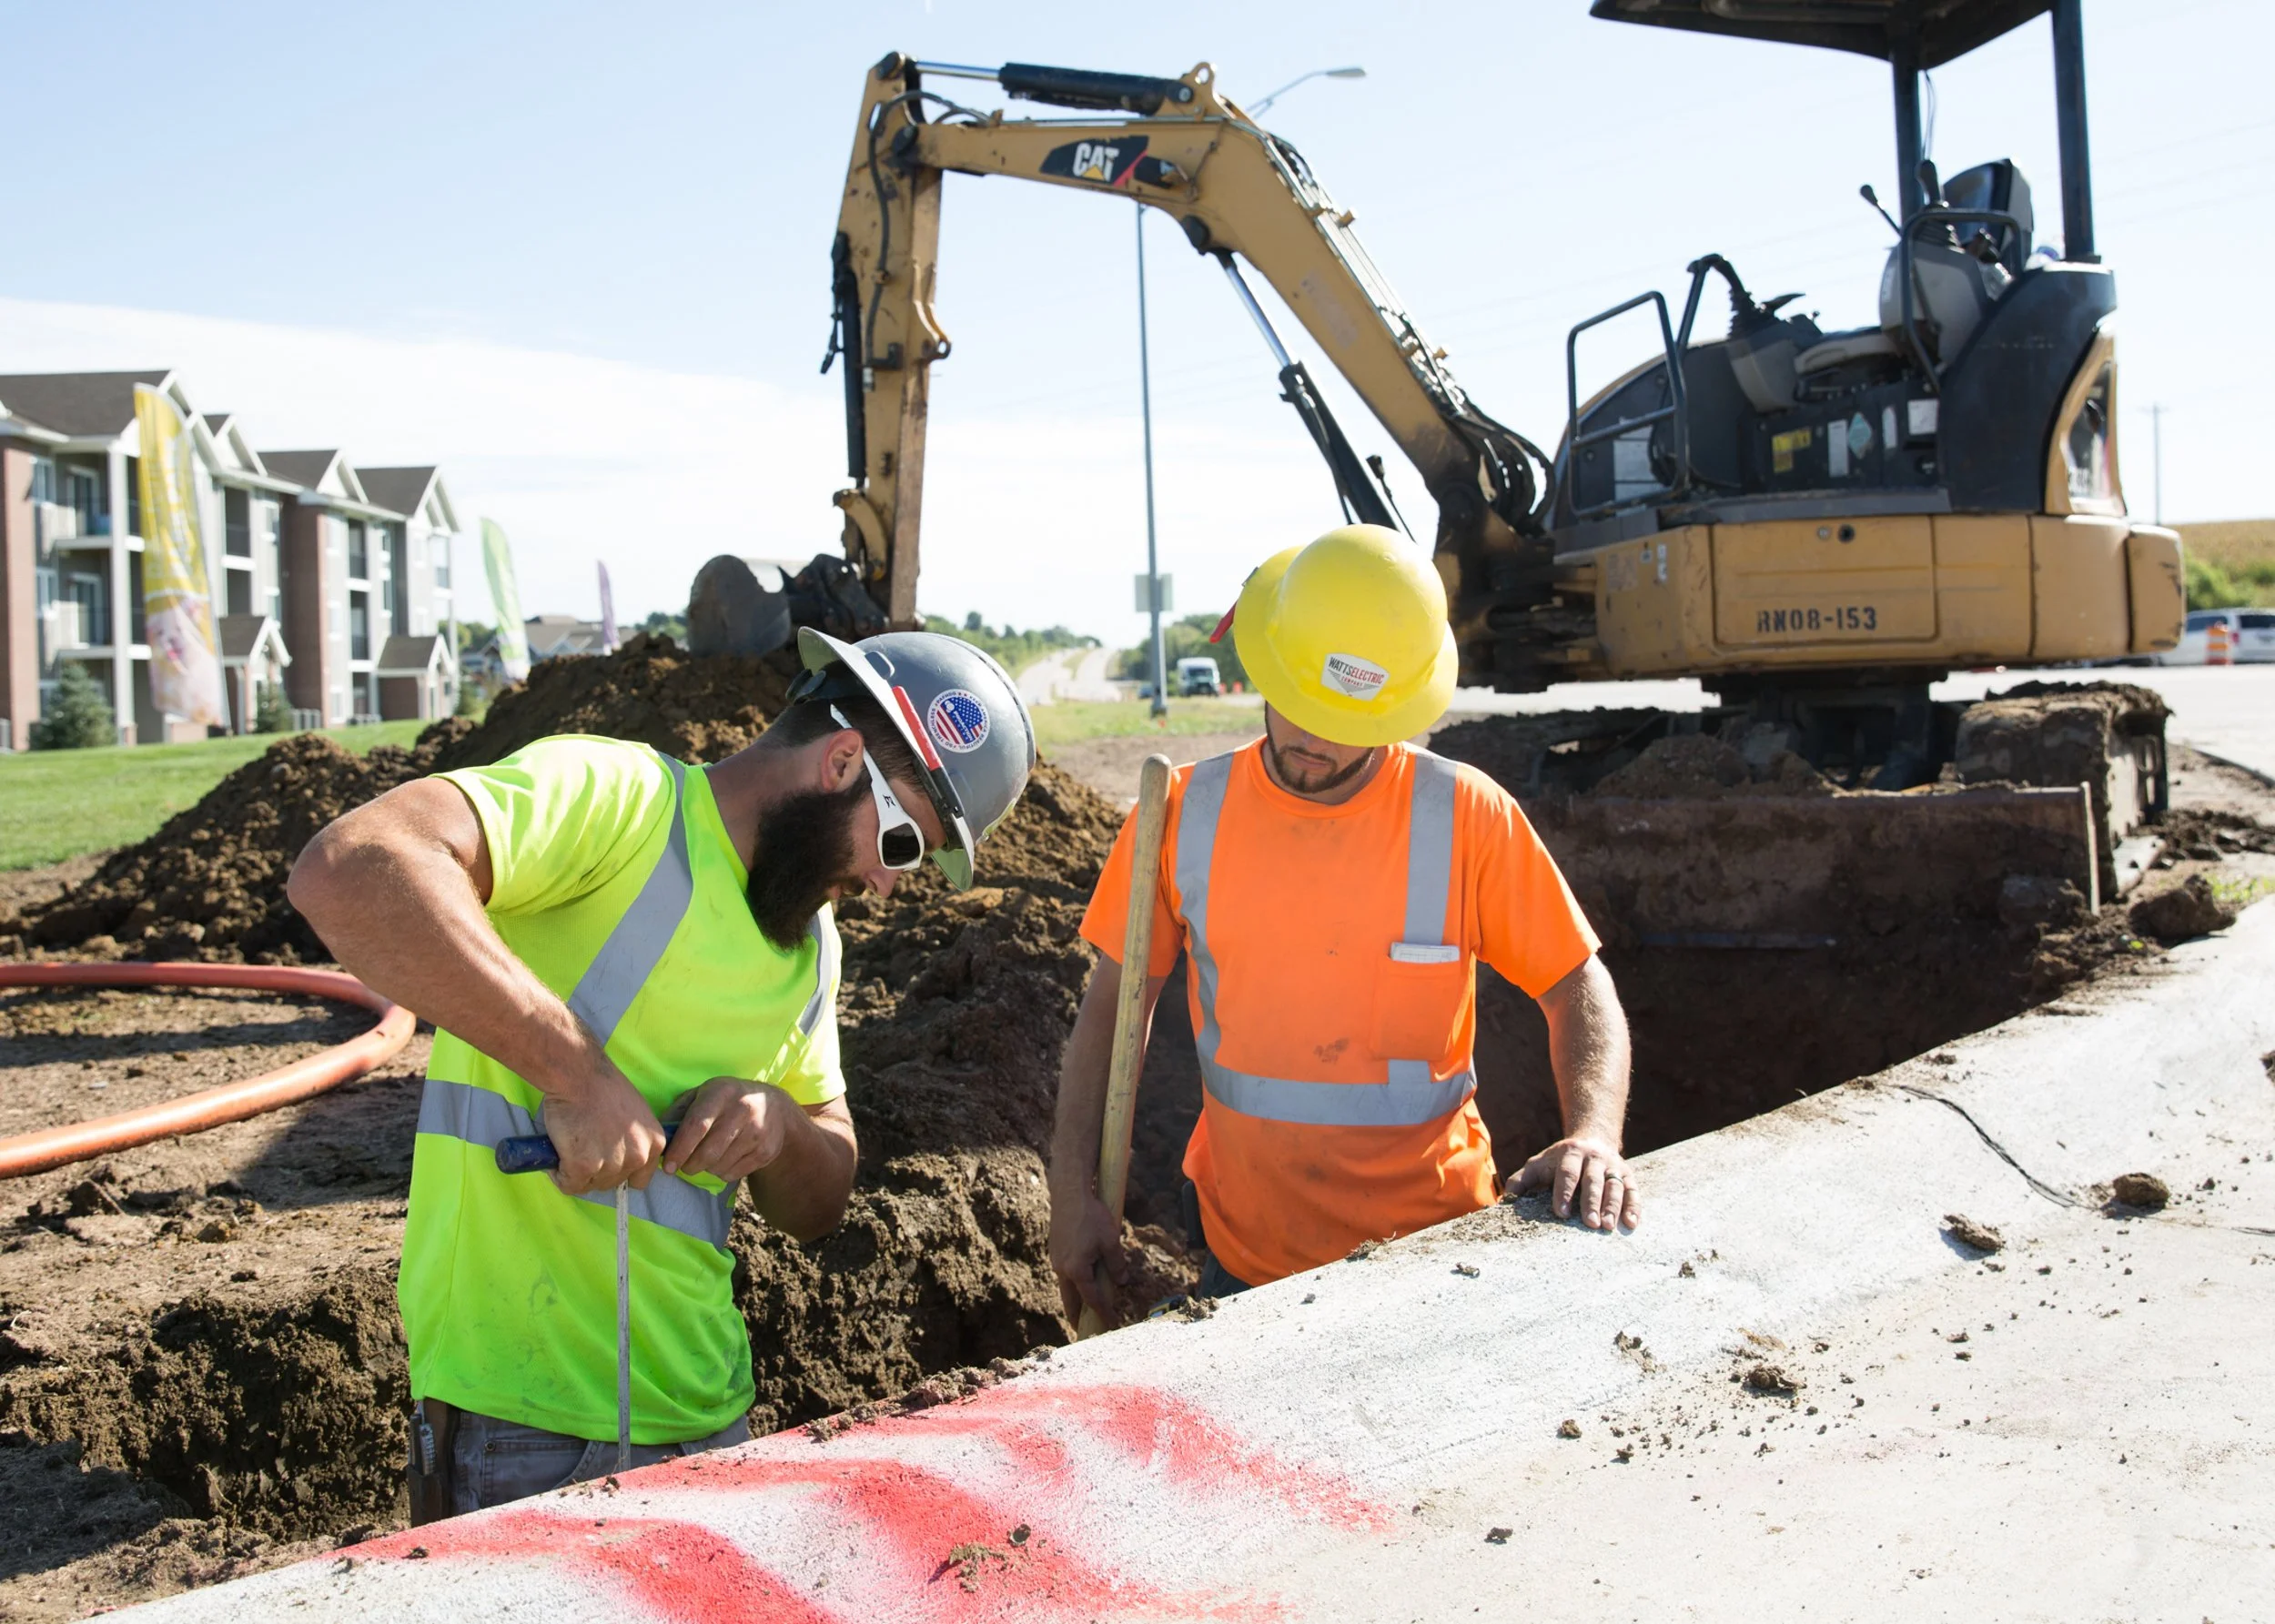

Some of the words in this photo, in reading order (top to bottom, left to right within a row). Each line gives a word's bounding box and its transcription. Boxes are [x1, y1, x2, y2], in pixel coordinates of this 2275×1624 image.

[1072, 142, 1120, 182] CAT
[1756, 605, 1877, 634] RN08-153
[1340, 675, 1364, 687] COMPANY
